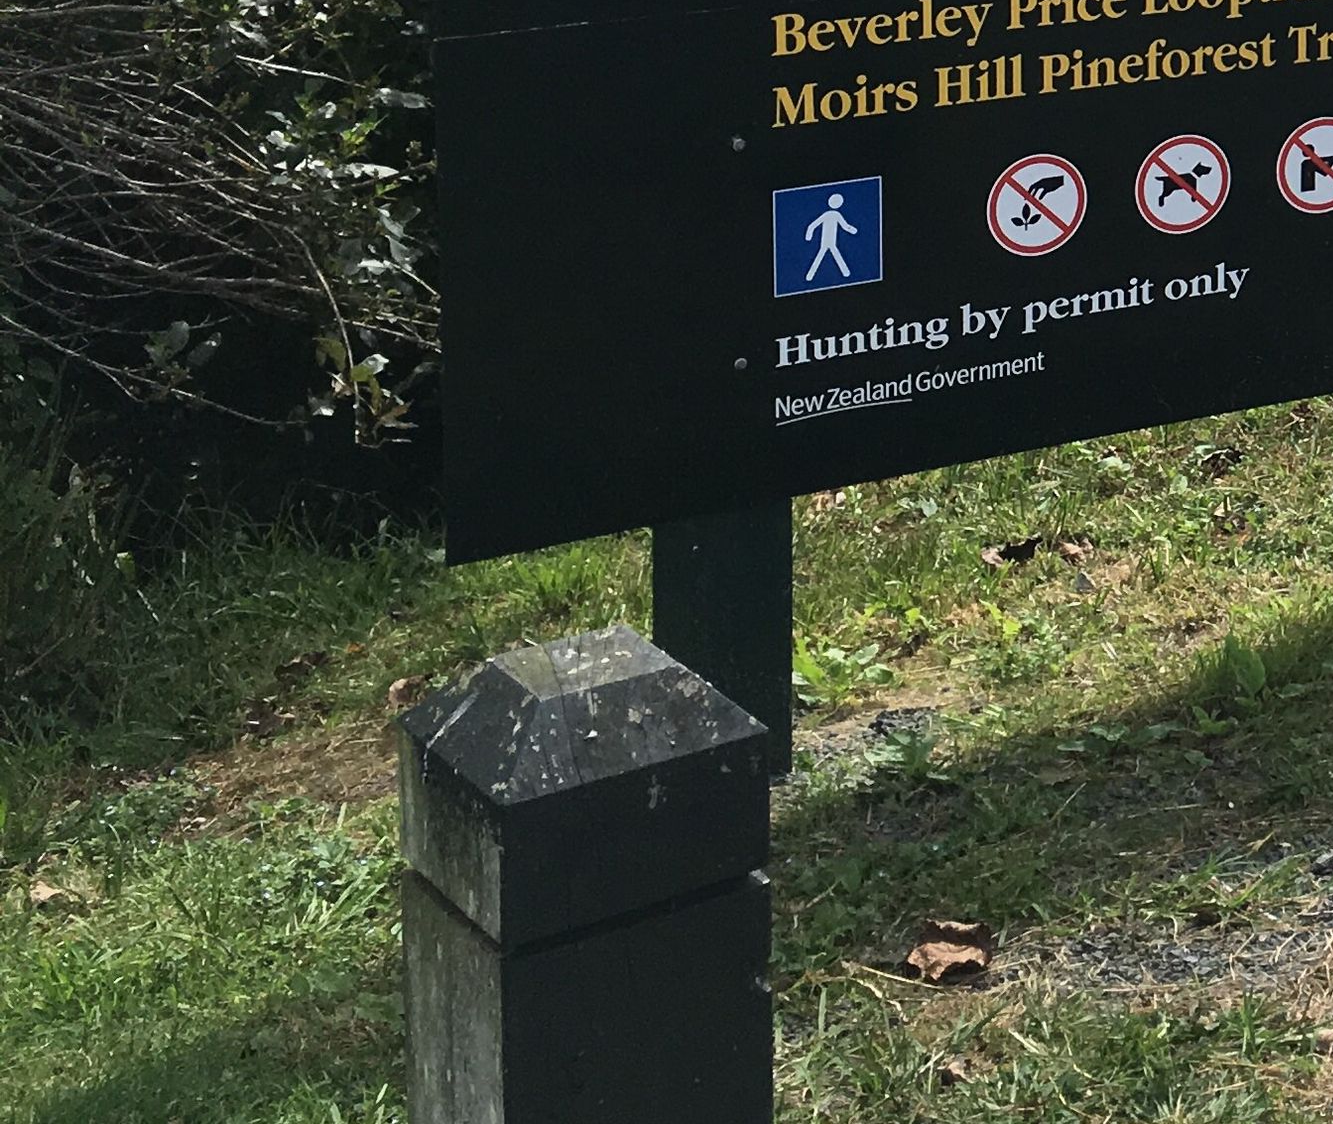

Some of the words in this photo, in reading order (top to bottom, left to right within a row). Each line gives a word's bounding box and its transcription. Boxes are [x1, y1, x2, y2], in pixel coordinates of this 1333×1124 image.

[772, 75, 918, 128] Moirs
[935, 54, 1026, 108] Hill
[1039, 34, 1275, 94] Pineforest
[775, 317, 949, 368] Hunting
[962, 303, 1011, 339] by
[1023, 277, 1154, 334] permit
[1164, 262, 1250, 300] only
[775, 393, 824, 418] New
[827, 374, 912, 409] Zealand
[917, 350, 1045, 393] Government
